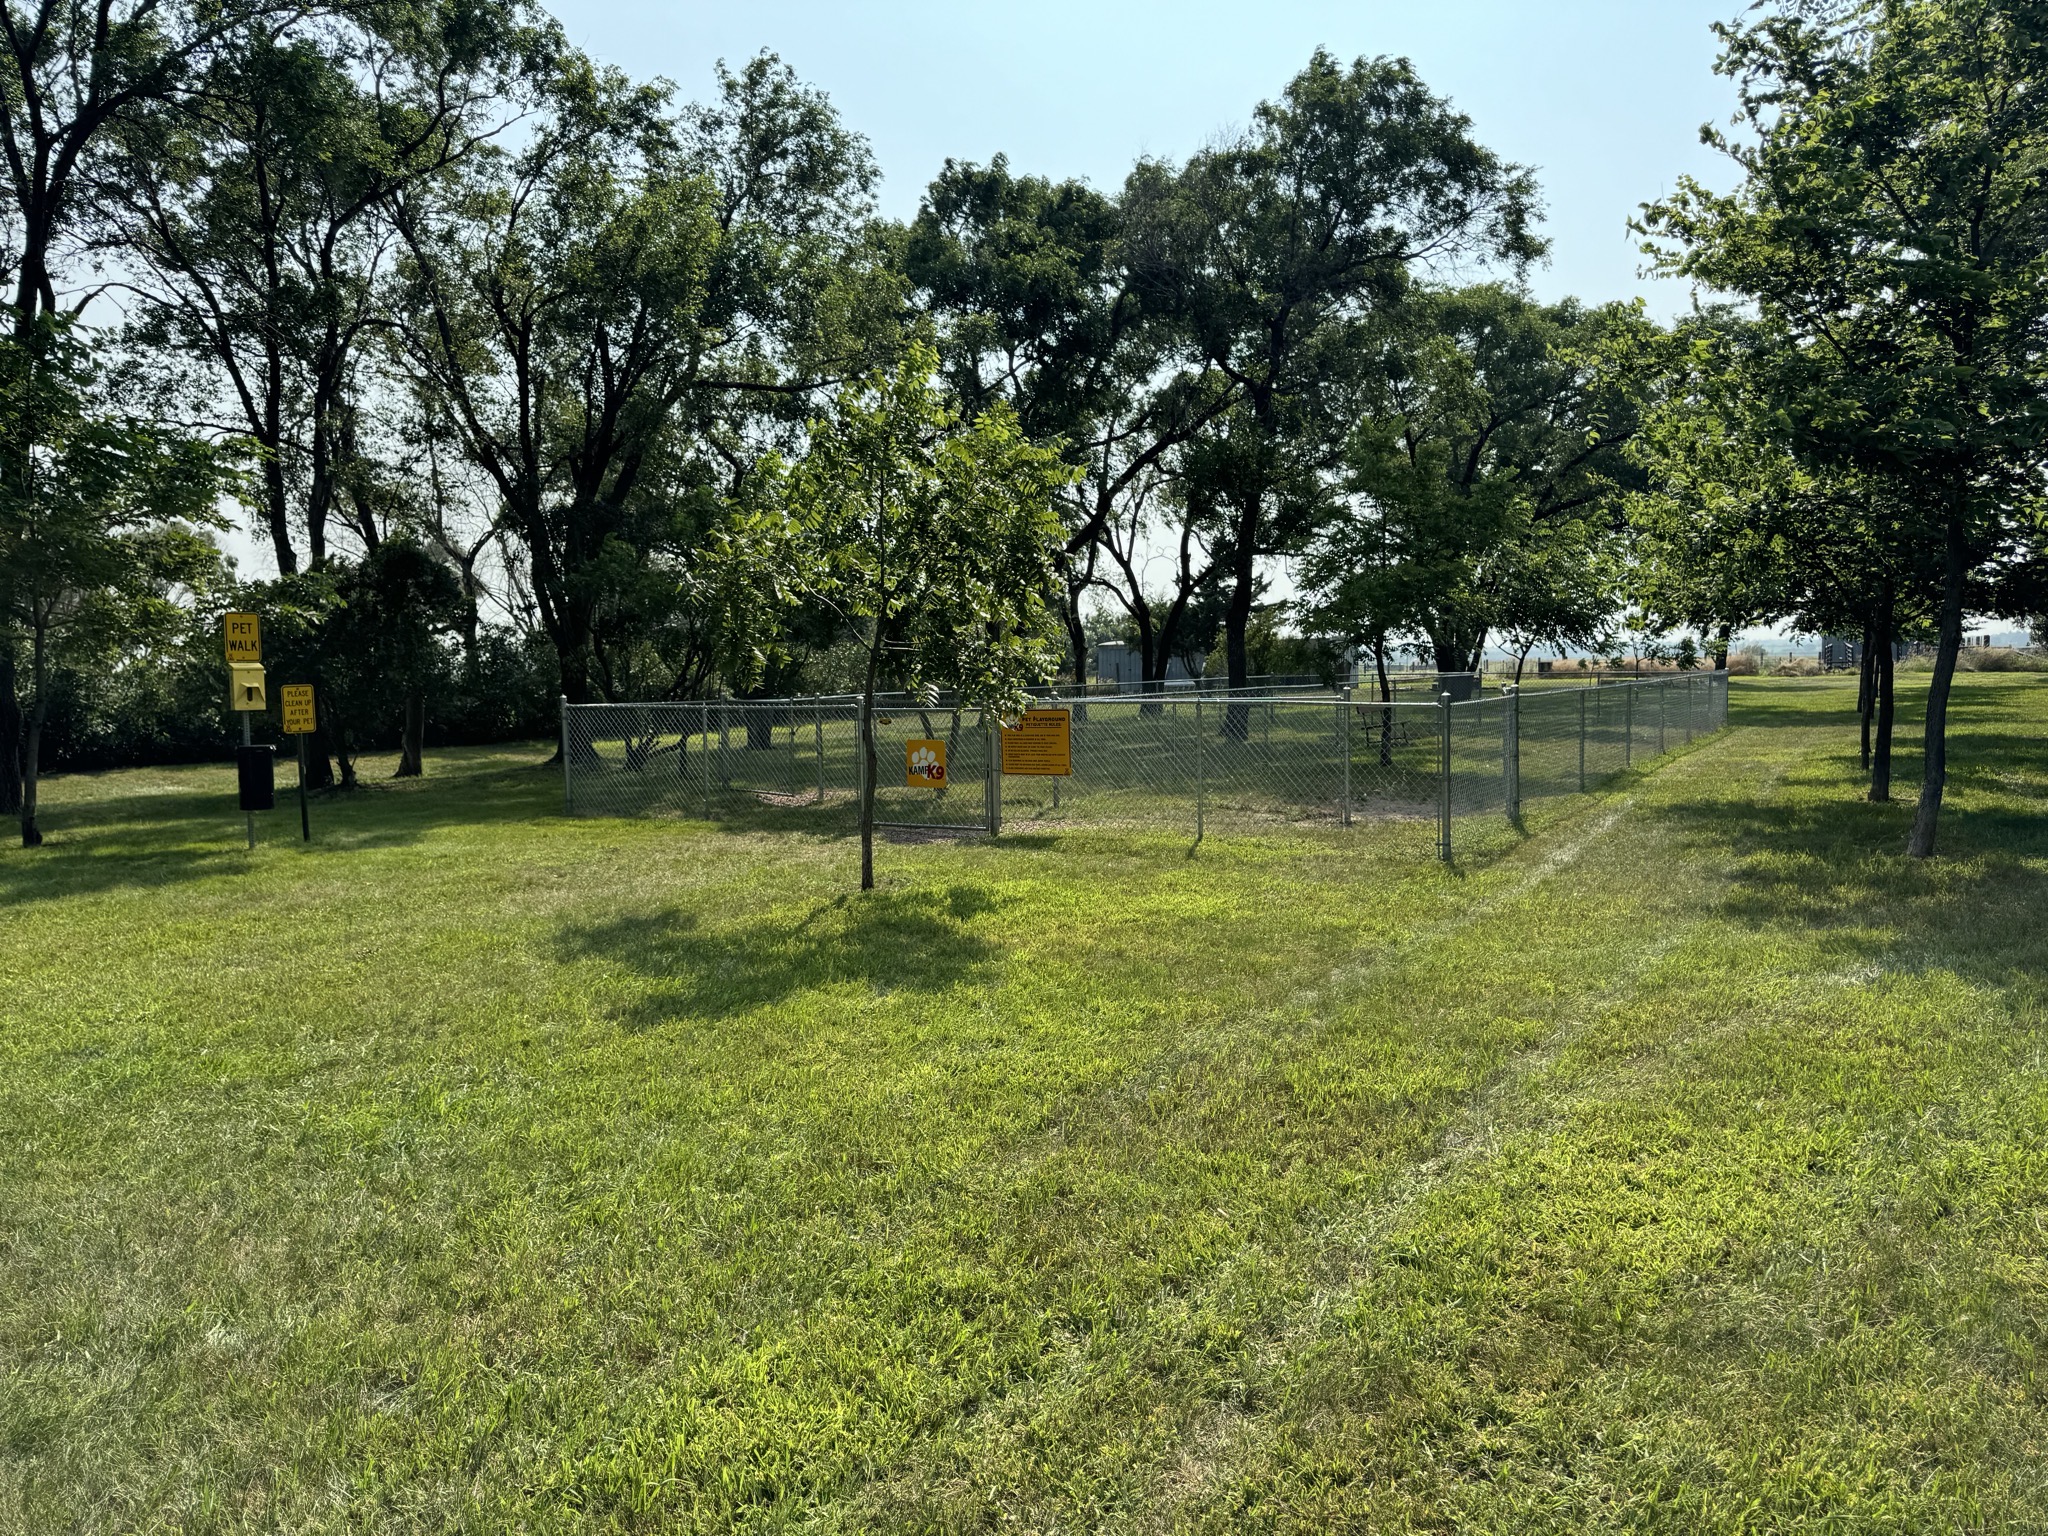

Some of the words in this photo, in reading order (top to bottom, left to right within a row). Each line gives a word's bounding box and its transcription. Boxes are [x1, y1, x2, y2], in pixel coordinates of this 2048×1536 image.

[232, 622, 252, 634] PET
[229, 640, 257, 651] WALK
[927, 764, 945, 780] K9
